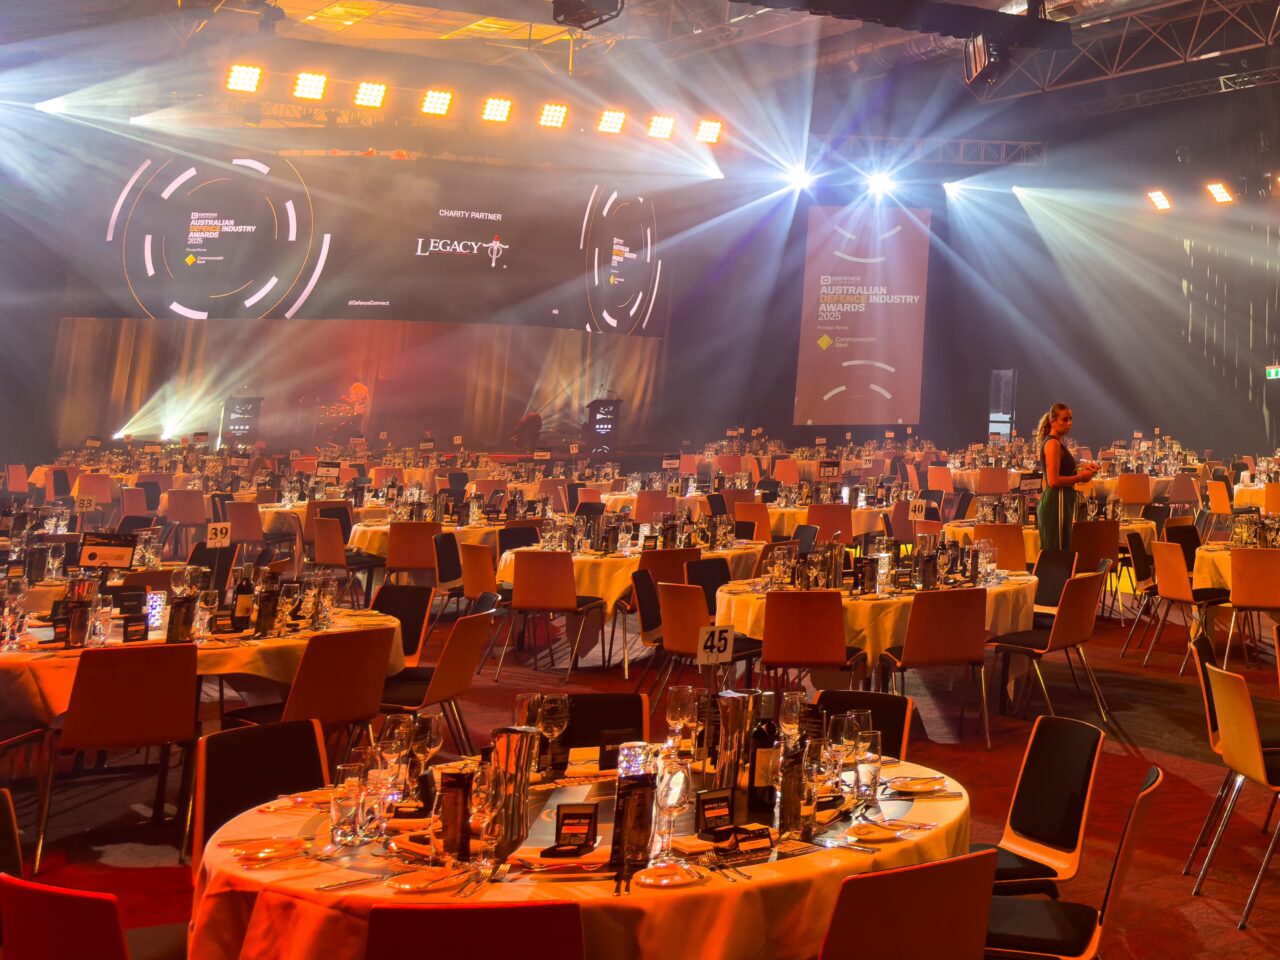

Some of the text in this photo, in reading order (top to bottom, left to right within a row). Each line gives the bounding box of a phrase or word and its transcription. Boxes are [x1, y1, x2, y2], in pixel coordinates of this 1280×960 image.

[439, 209, 502, 221] CHARITY PARTNER
[416, 238, 482, 256] LEGACY
[820, 286, 887, 294] AUSTRALIAN
[819, 294, 920, 304] DEFENCE INDUSTRY
[819, 303, 865, 312] AWARDS
[818, 311, 841, 320] 2025
[77, 499, 92, 508] 33
[911, 504, 923, 514] 40
[209, 526, 228, 540] 39
[703, 629, 728, 654] 45
